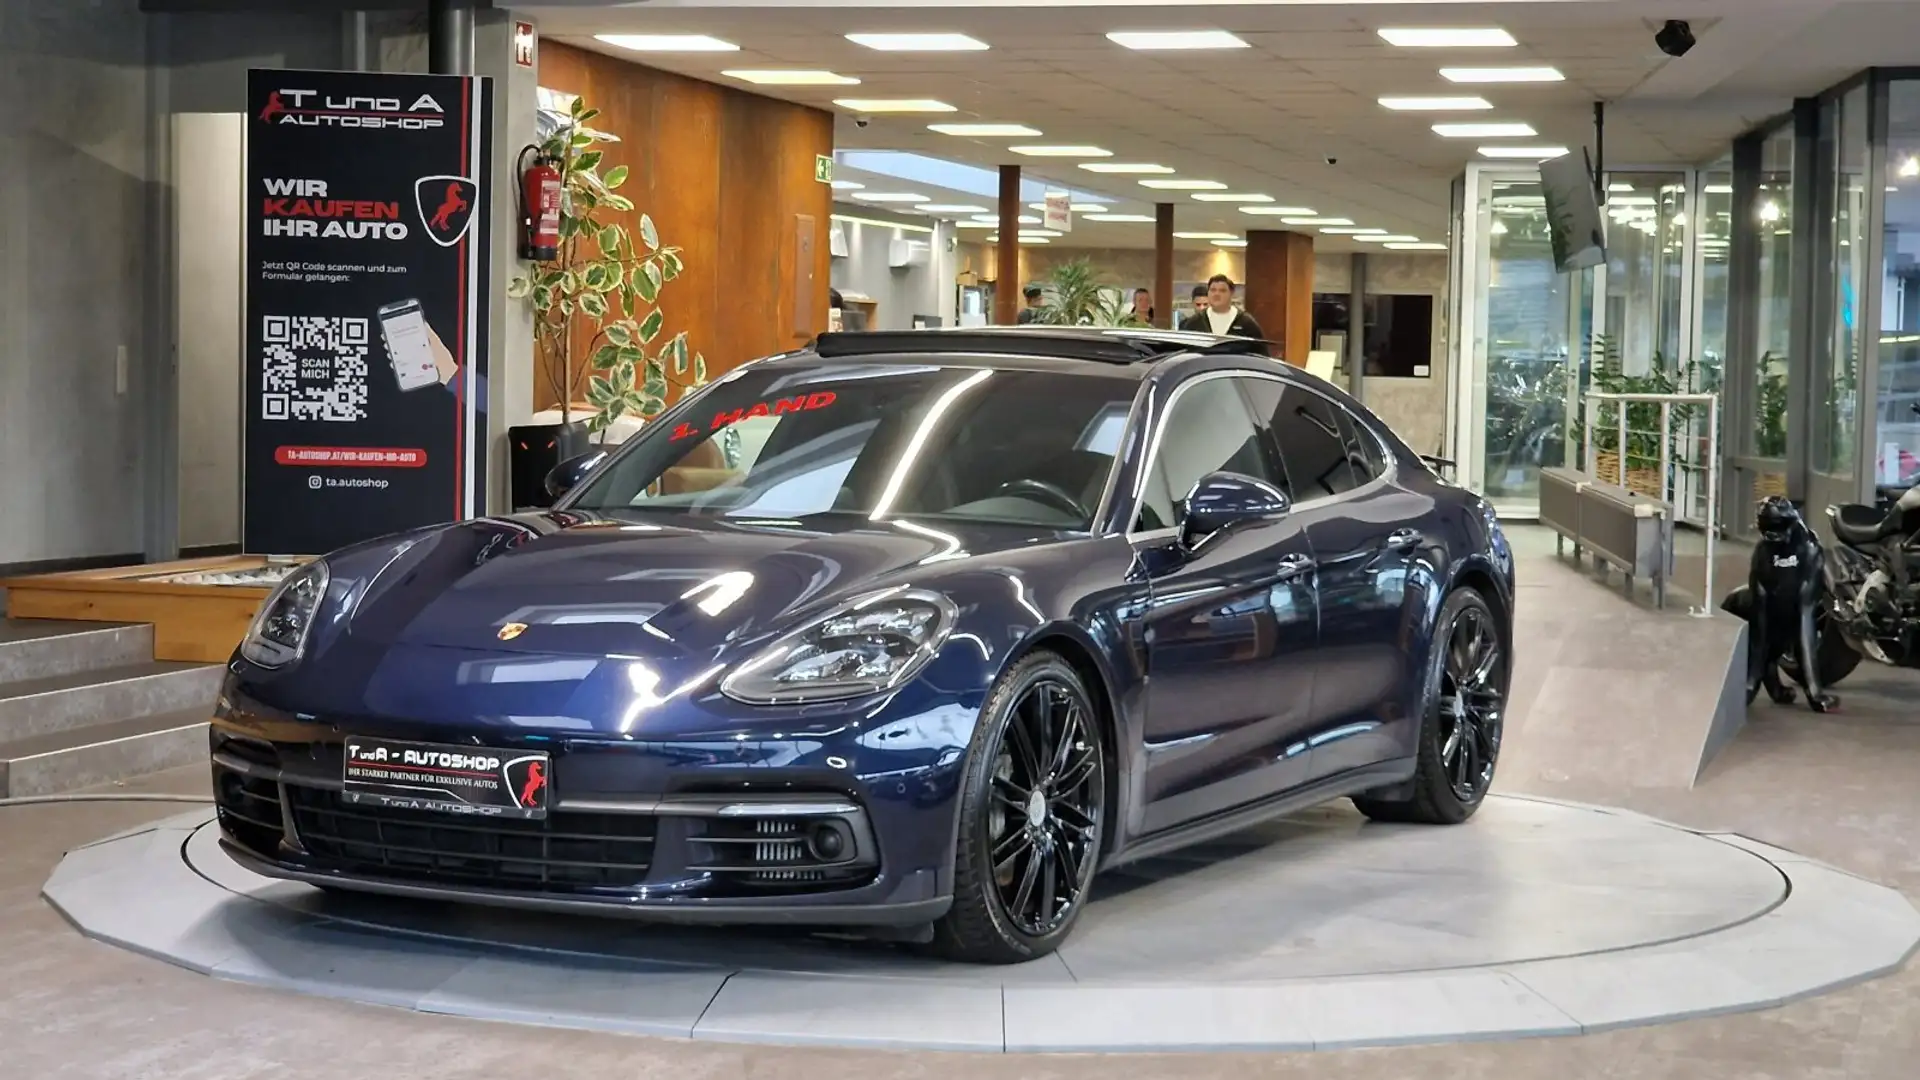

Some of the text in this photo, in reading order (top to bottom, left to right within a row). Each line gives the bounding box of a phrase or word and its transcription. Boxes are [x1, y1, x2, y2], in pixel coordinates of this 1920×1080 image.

[279, 88, 317, 108] T
[408, 93, 445, 113] A
[279, 114, 444, 130] AUTOSHOP
[262, 178, 328, 197] WIR
[263, 198, 399, 219] KAUFEN
[263, 218, 408, 240] IHR AUTO
[262, 260, 408, 274] Jetzt QR Code scannen und zum
[262, 271, 351, 283] Formular gelangen:
[301, 358, 330, 369] SCAN
[301, 369, 330, 379] MICH
[710, 392, 837, 429] HAND
[325, 477, 389, 489] ta.autoshop
[404, 749, 500, 771] AUTOSHOP
[390, 771, 420, 782] PARTNER
[435, 775, 473, 787] EXKLUSIVE
[473, 780, 499, 790] AUTOS
[424, 801, 502, 815] AUTOSHOP
